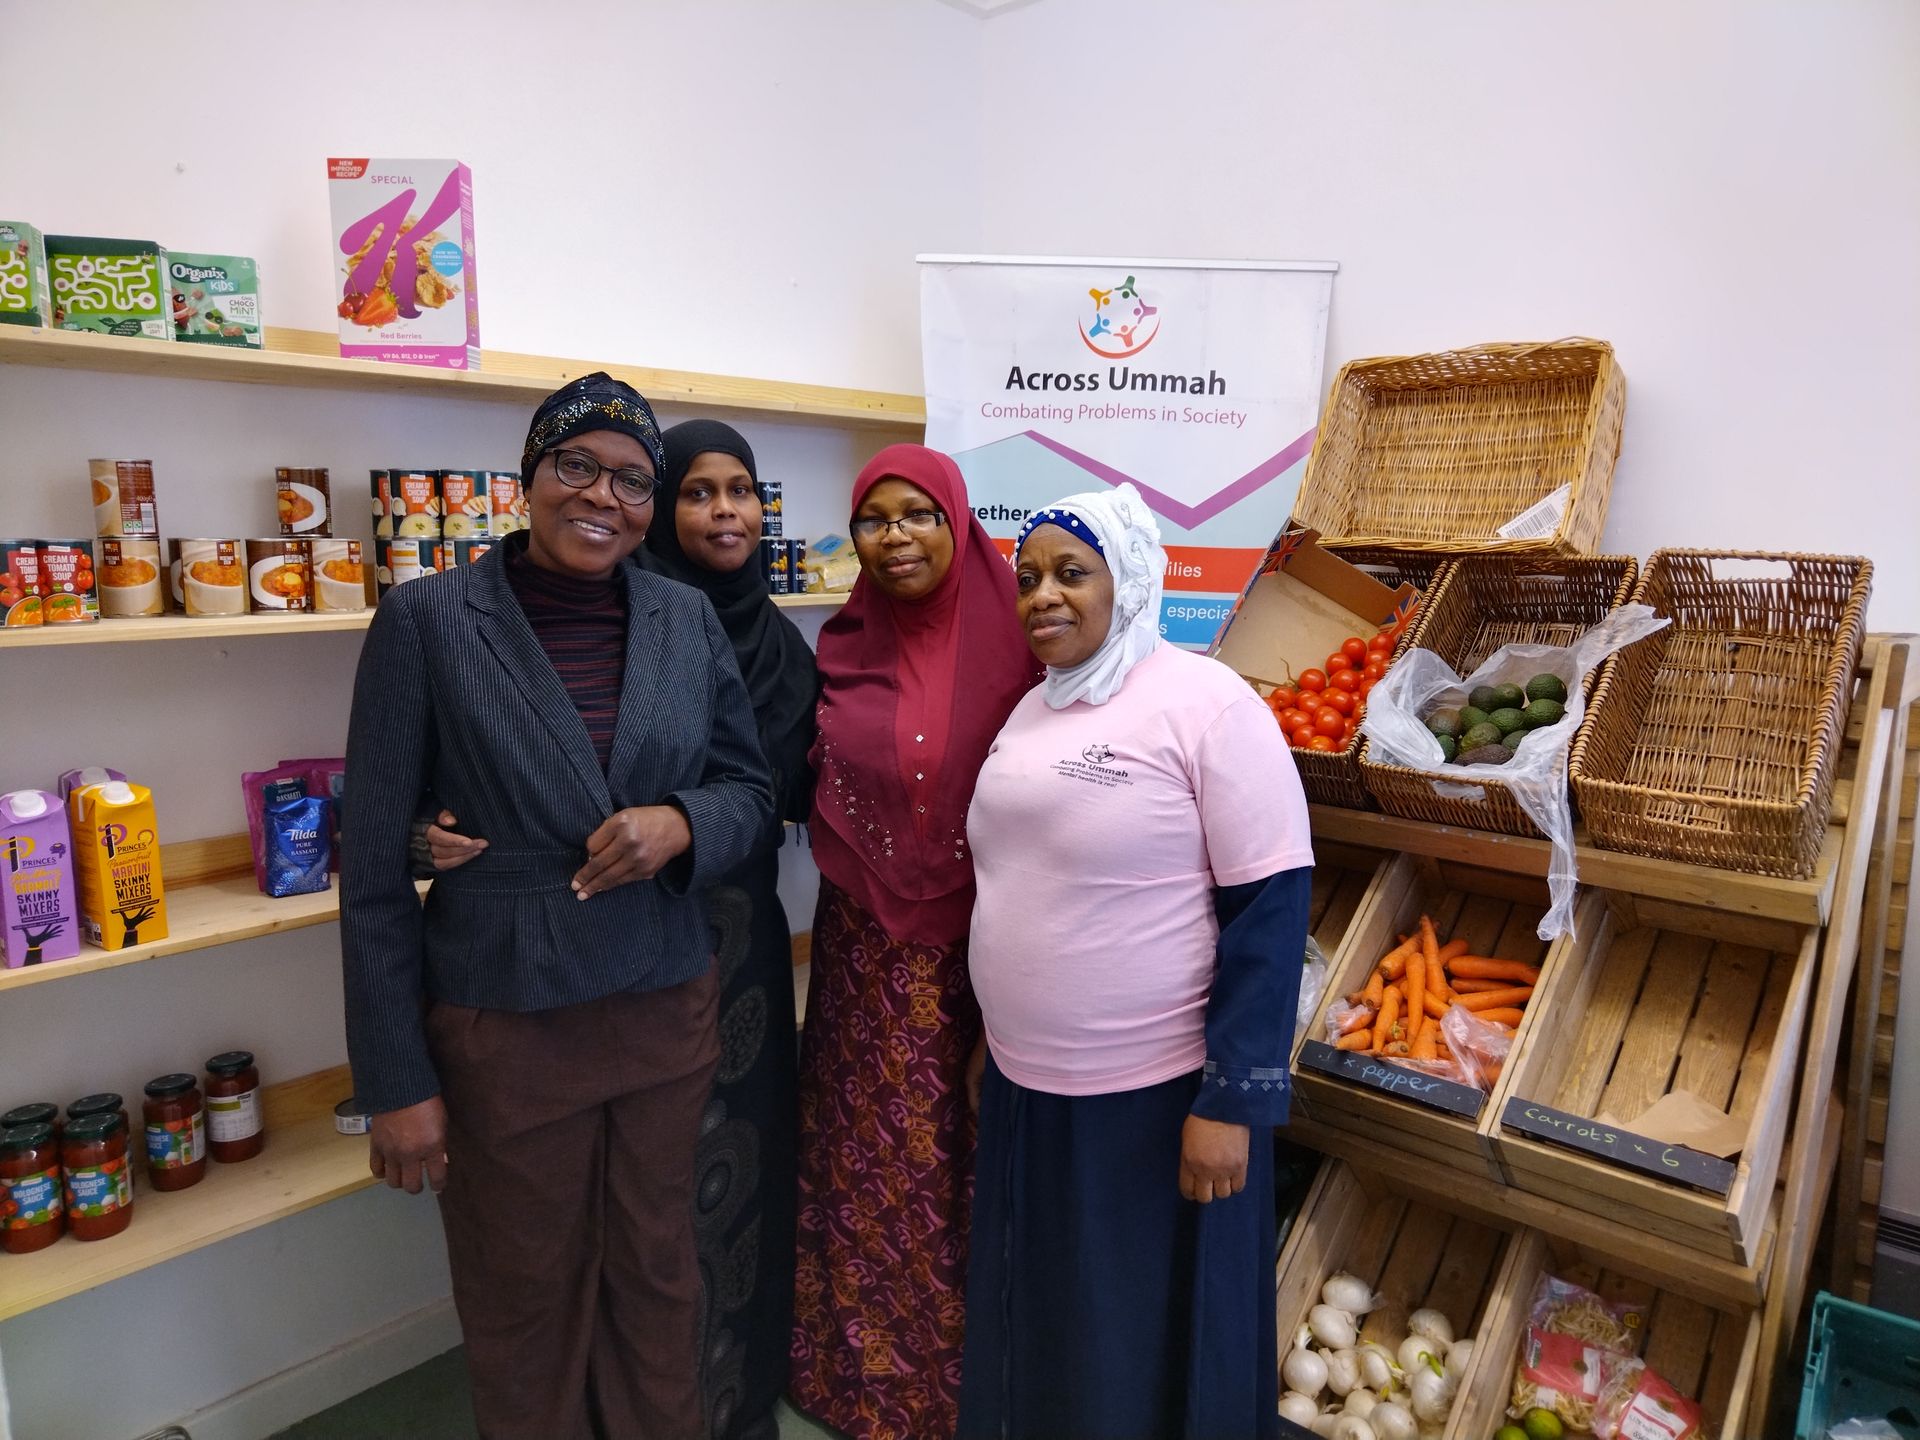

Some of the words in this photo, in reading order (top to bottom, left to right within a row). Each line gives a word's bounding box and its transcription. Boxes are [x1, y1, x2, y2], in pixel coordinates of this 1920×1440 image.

[371, 175, 414, 185] SPECIAL
[339, 167, 461, 319] K
[172, 264, 225, 283] Organix
[380, 332, 395, 340] Red
[396, 332, 423, 340] Berries
[1005, 366, 1100, 392] Across
[1109, 366, 1226, 396] Ummah
[981, 402, 1073, 424] Combating
[1079, 403, 1156, 421] Problems
[1162, 405, 1177, 422] in
[1183, 407, 1247, 429] Society
[43, 555, 67, 564] CREAM
[69, 555, 78, 564] OF
[47, 563, 76, 572] TOMATO
[53, 572, 72, 581] SOUP
[1167, 605, 1230, 622] especia
[1059, 760, 1086, 768] Across
[1088, 764, 1128, 777] Ummah
[1076, 768, 1103, 779] Problems
[285, 828, 318, 841] Tilda
[117, 841, 147, 853] PRINCES
[296, 841, 313, 849] PURE
[22, 856, 57, 867] PRINCES
[112, 861, 151, 880] MARTINI
[114, 873, 150, 889] SKINNY
[17, 888, 60, 904] SKINNY
[116, 882, 152, 901] MIXERS
[19, 898, 60, 917] MIXERS
[1361, 1064, 1442, 1093] pepper
[1661, 1148, 1680, 1167] 6
[13, 1181, 52, 1199] BOLOGNESE
[70, 1177, 107, 1189] BOLOGNESE
[22, 1192, 45, 1206] SAUCE
[77, 1187, 98, 1197] SAUCE
